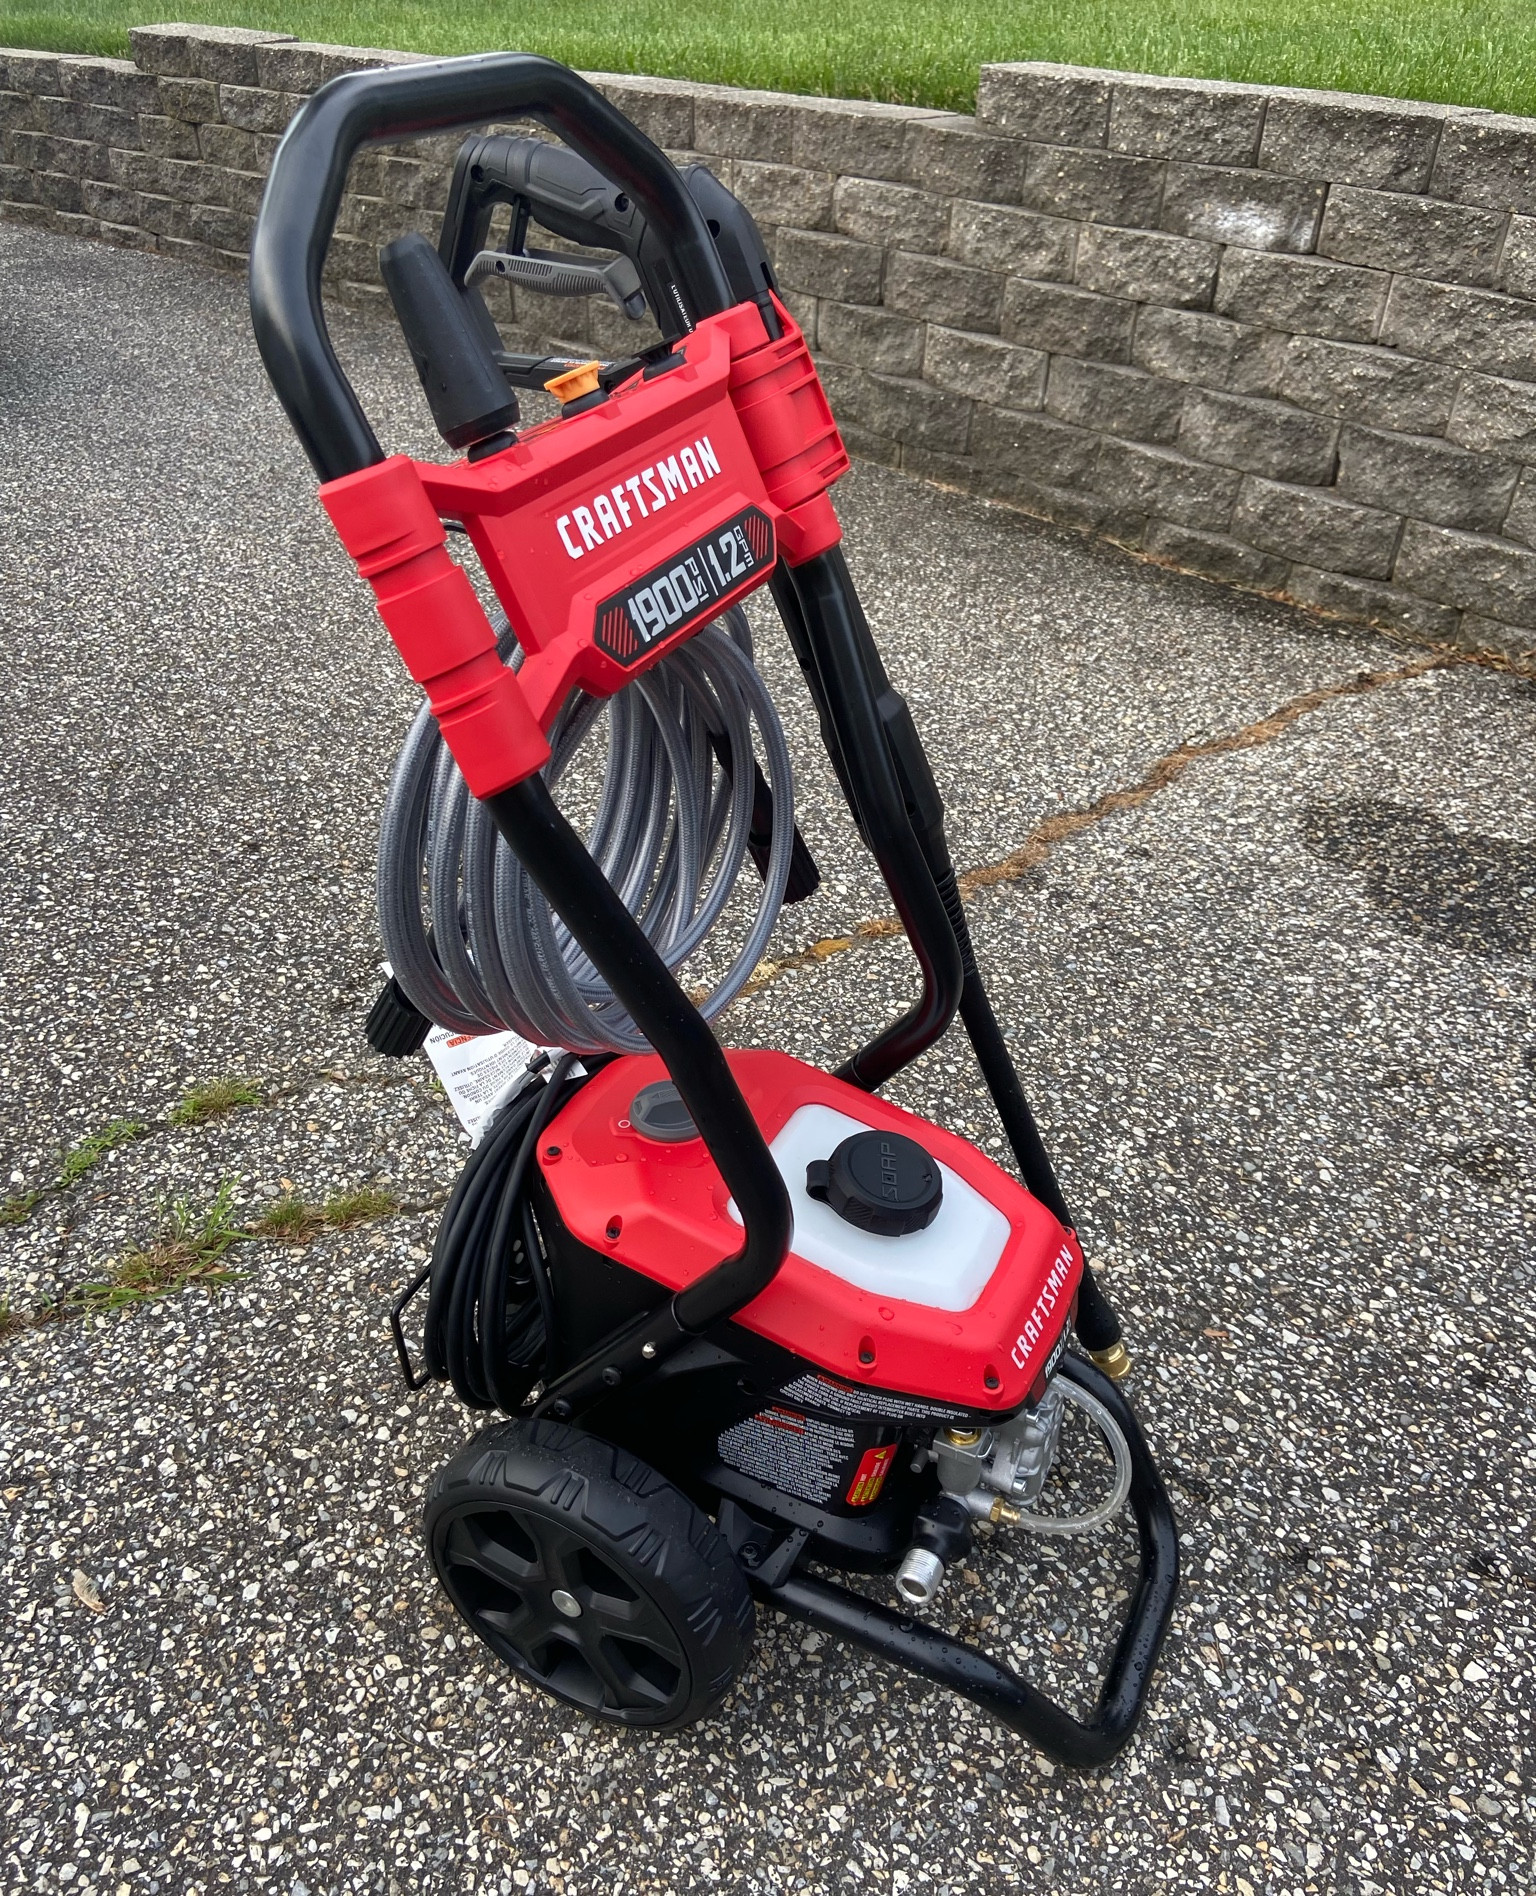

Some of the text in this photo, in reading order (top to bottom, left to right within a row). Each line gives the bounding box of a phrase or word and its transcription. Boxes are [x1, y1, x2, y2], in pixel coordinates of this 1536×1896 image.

[556, 436, 721, 560] CRAFTSMAN
[628, 525, 755, 643] 1900 PSI 1.2 GPM
[881, 1142, 899, 1202] SOAP
[1011, 1244, 1073, 1370] CRAFTSMAN
